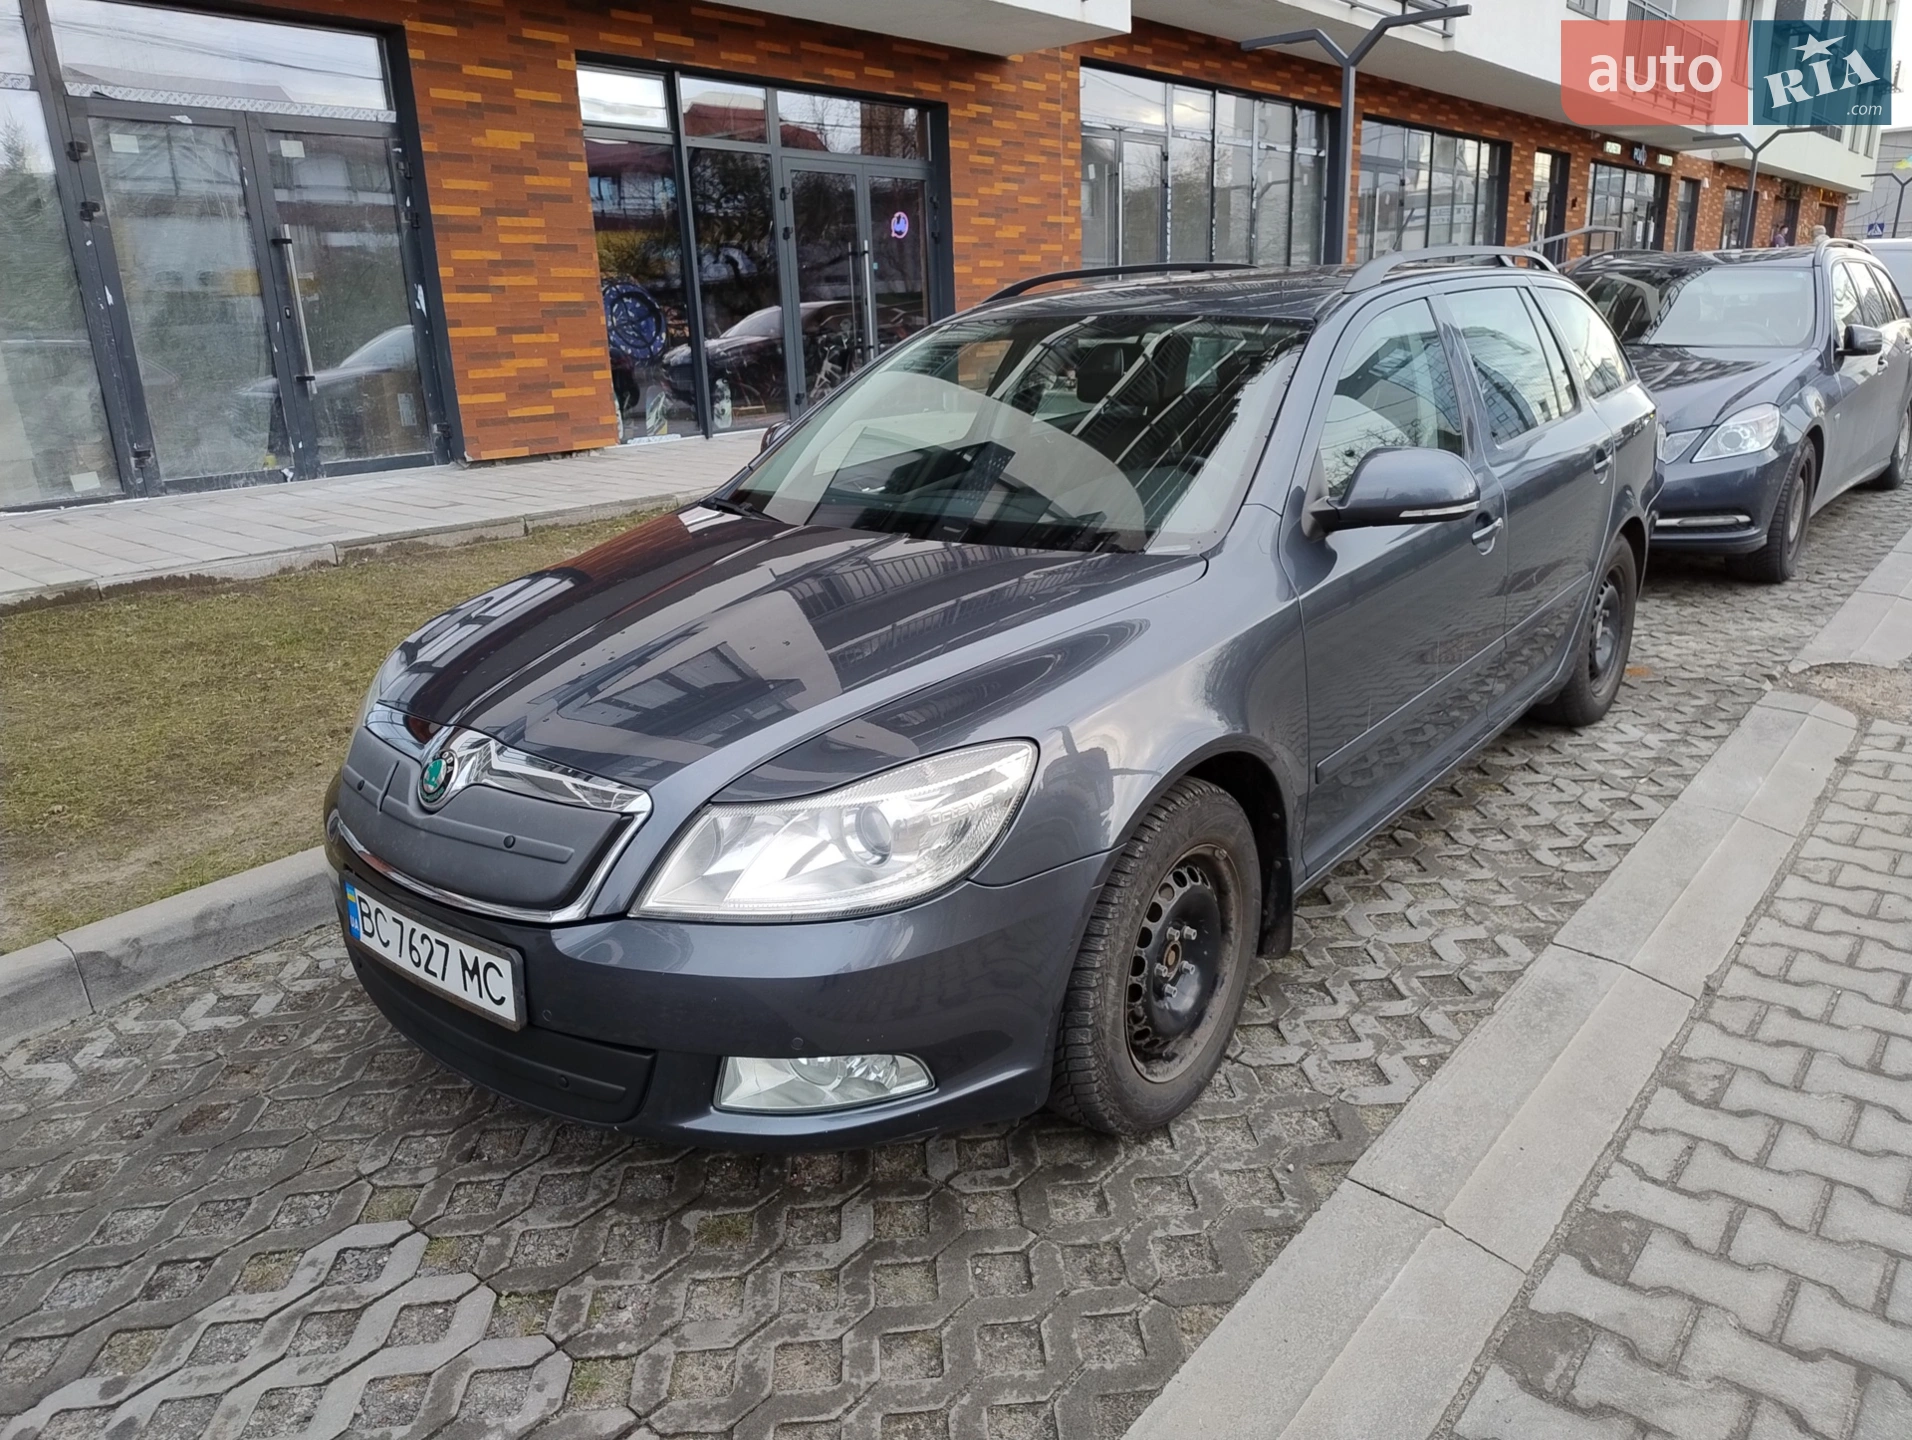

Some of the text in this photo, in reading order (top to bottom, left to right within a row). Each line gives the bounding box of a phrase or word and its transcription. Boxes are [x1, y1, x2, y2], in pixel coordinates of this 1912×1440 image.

[350, 914, 360, 931] UA
[357, 896, 506, 1006] BC 7627 MC
